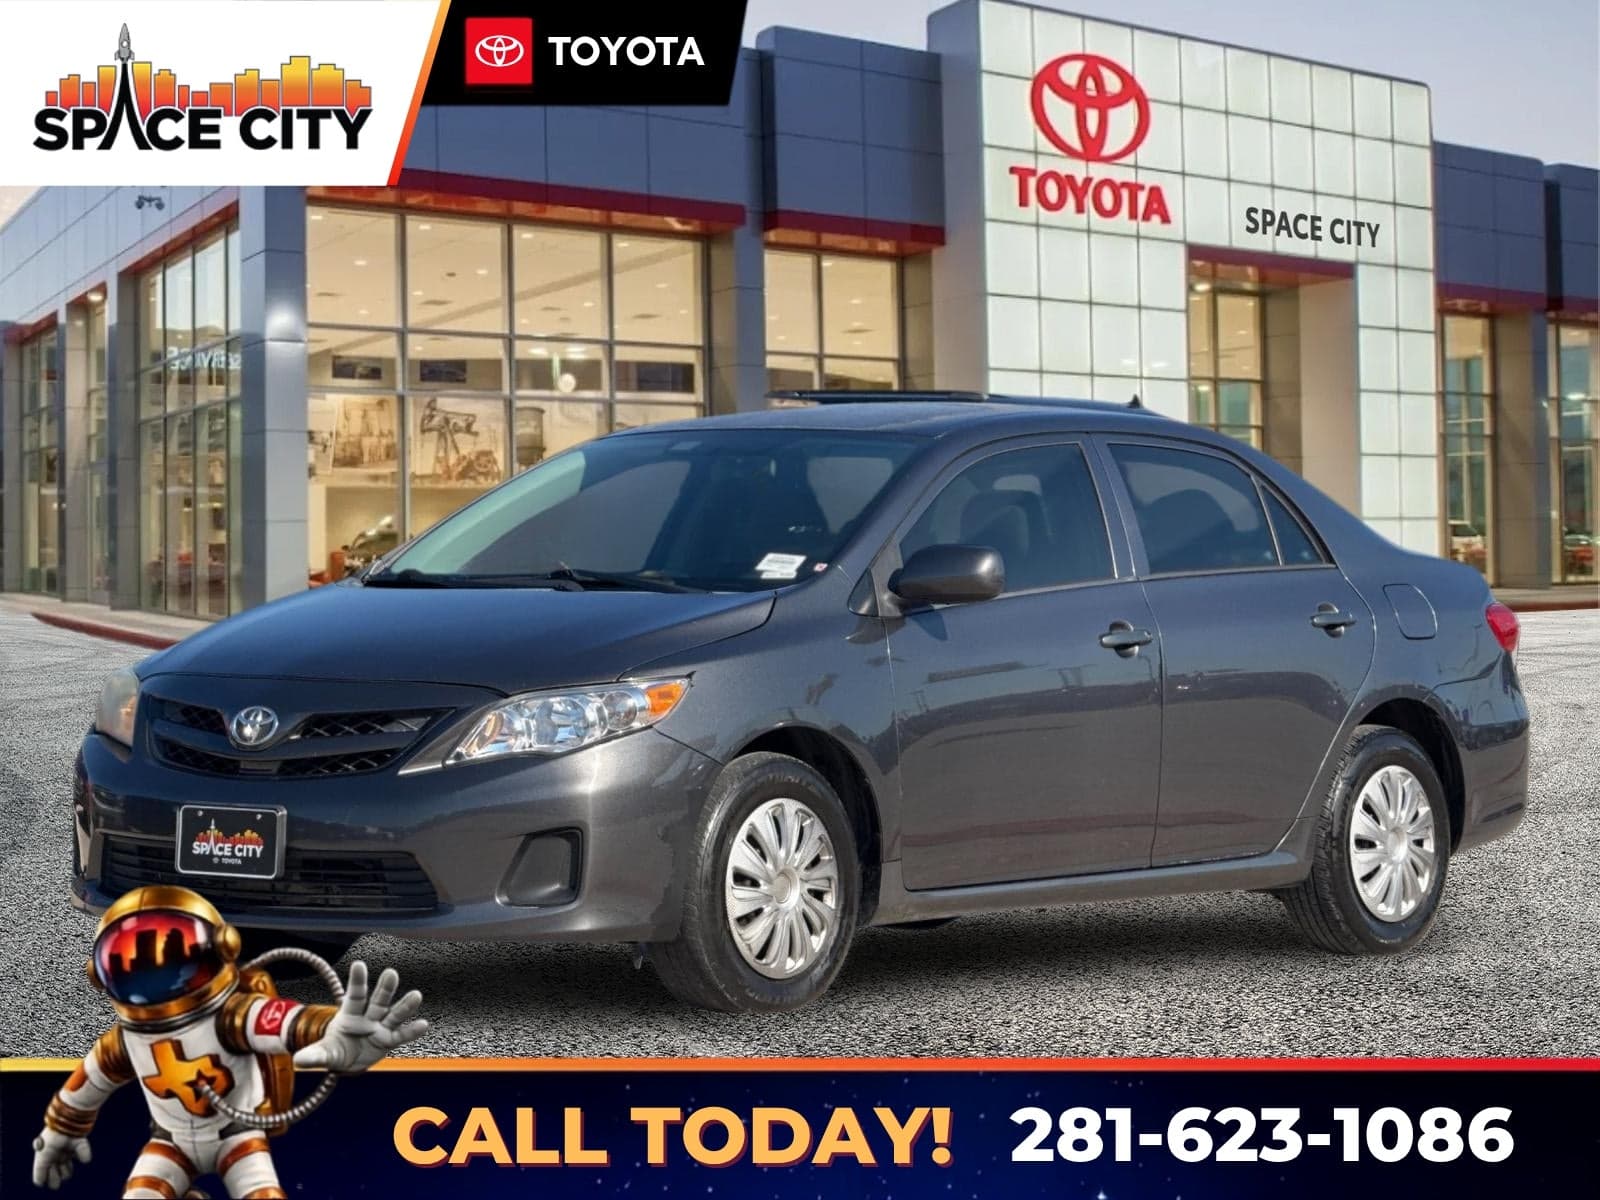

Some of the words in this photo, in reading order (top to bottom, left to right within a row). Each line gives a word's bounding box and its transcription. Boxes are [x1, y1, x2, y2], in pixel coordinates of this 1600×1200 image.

[1008, 166, 1172, 225] TOYOTA
[1245, 206, 1323, 242] SPACE
[1329, 217, 1381, 248] CITY
[192, 838, 232, 856] SPACE
[234, 844, 264, 858] CITY
